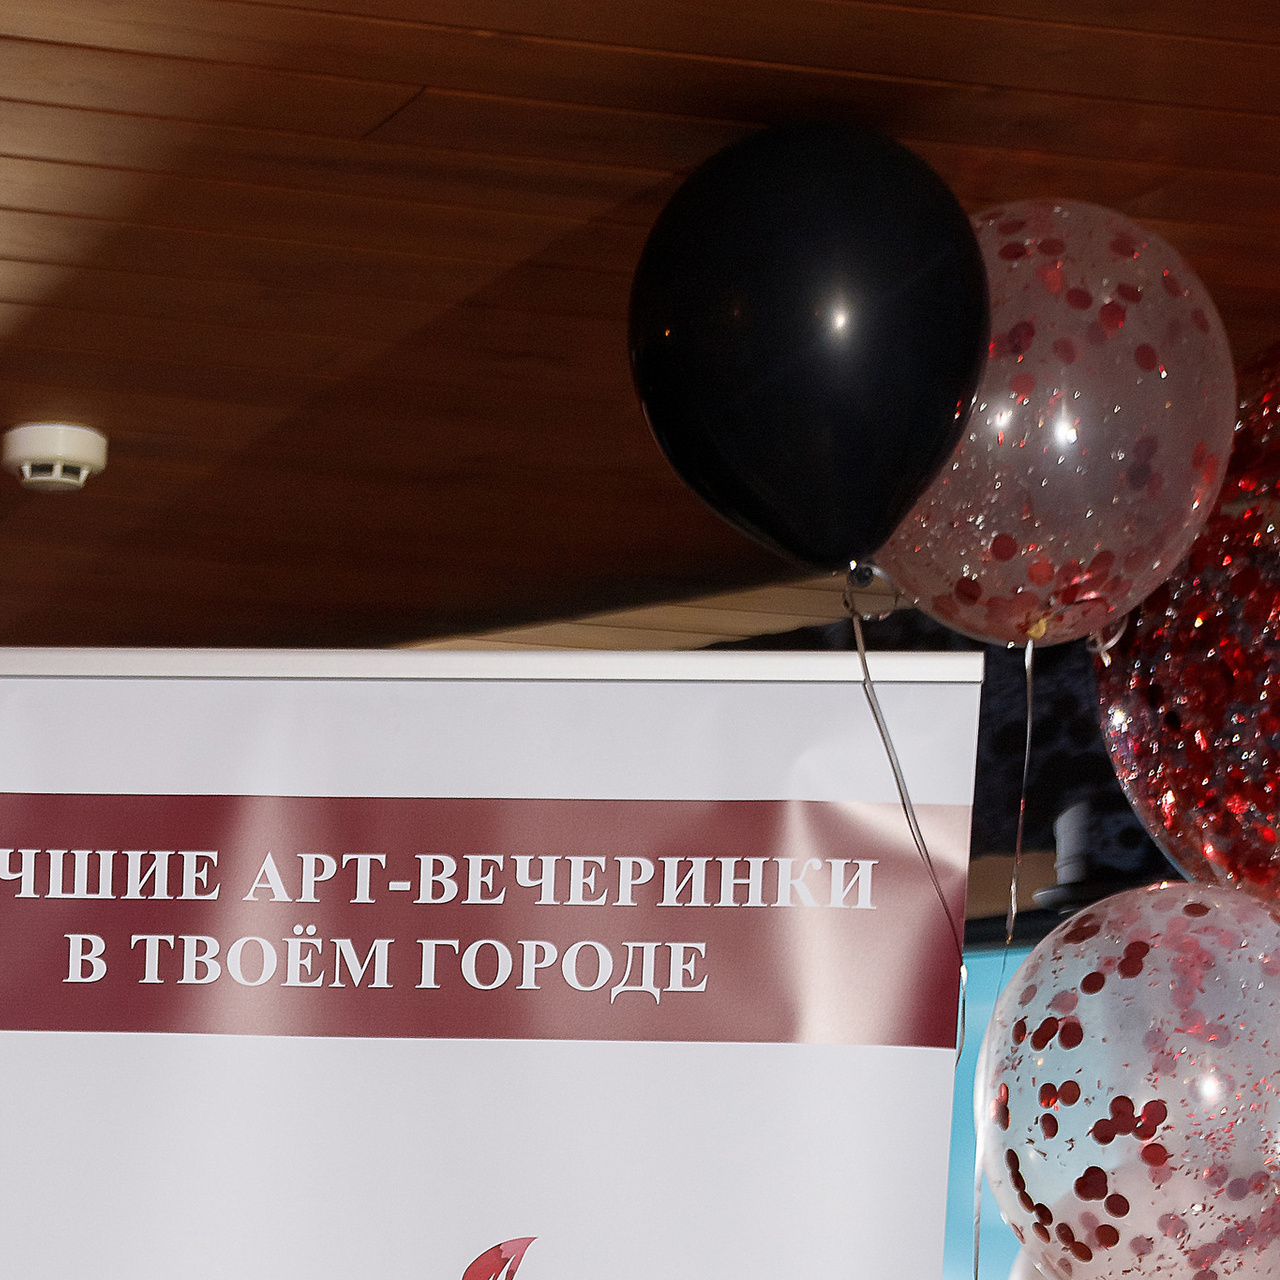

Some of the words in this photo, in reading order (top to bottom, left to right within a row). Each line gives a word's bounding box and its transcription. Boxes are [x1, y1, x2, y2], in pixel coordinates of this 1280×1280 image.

[241, 850, 878, 911] АРТ-ВЕЧЕРИНКИ
[63, 933, 107, 984] В
[130, 924, 395, 992] ТВОЁМ
[414, 938, 709, 1005] ГОРОДЕ
